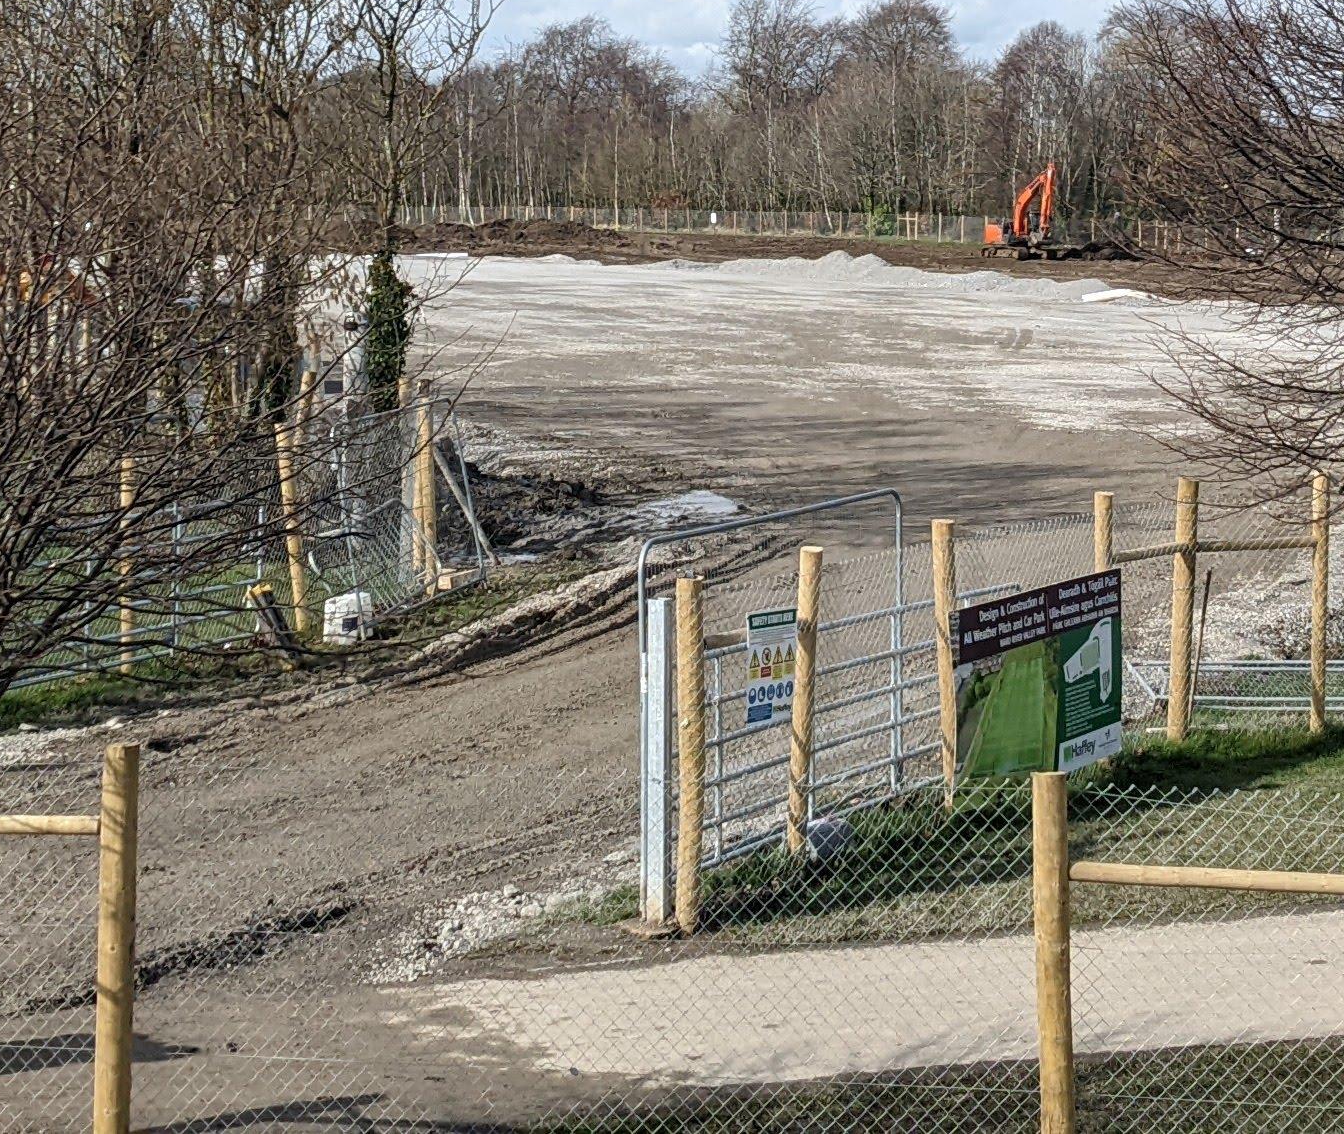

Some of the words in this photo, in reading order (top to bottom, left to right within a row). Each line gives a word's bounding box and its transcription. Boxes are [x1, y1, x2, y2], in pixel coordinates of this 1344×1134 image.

[1081, 582, 1087, 594] &
[978, 608, 999, 622] Design
[1000, 605, 1006, 617] &
[1006, 596, 1038, 615] Construction
[1038, 592, 1045, 605] of
[963, 630, 973, 645] All
[972, 626, 998, 642] Weather
[998, 621, 1012, 635] Pitch
[1012, 616, 1023, 631] and
[1023, 615, 1033, 627] Car
[1033, 610, 1045, 624] Park
